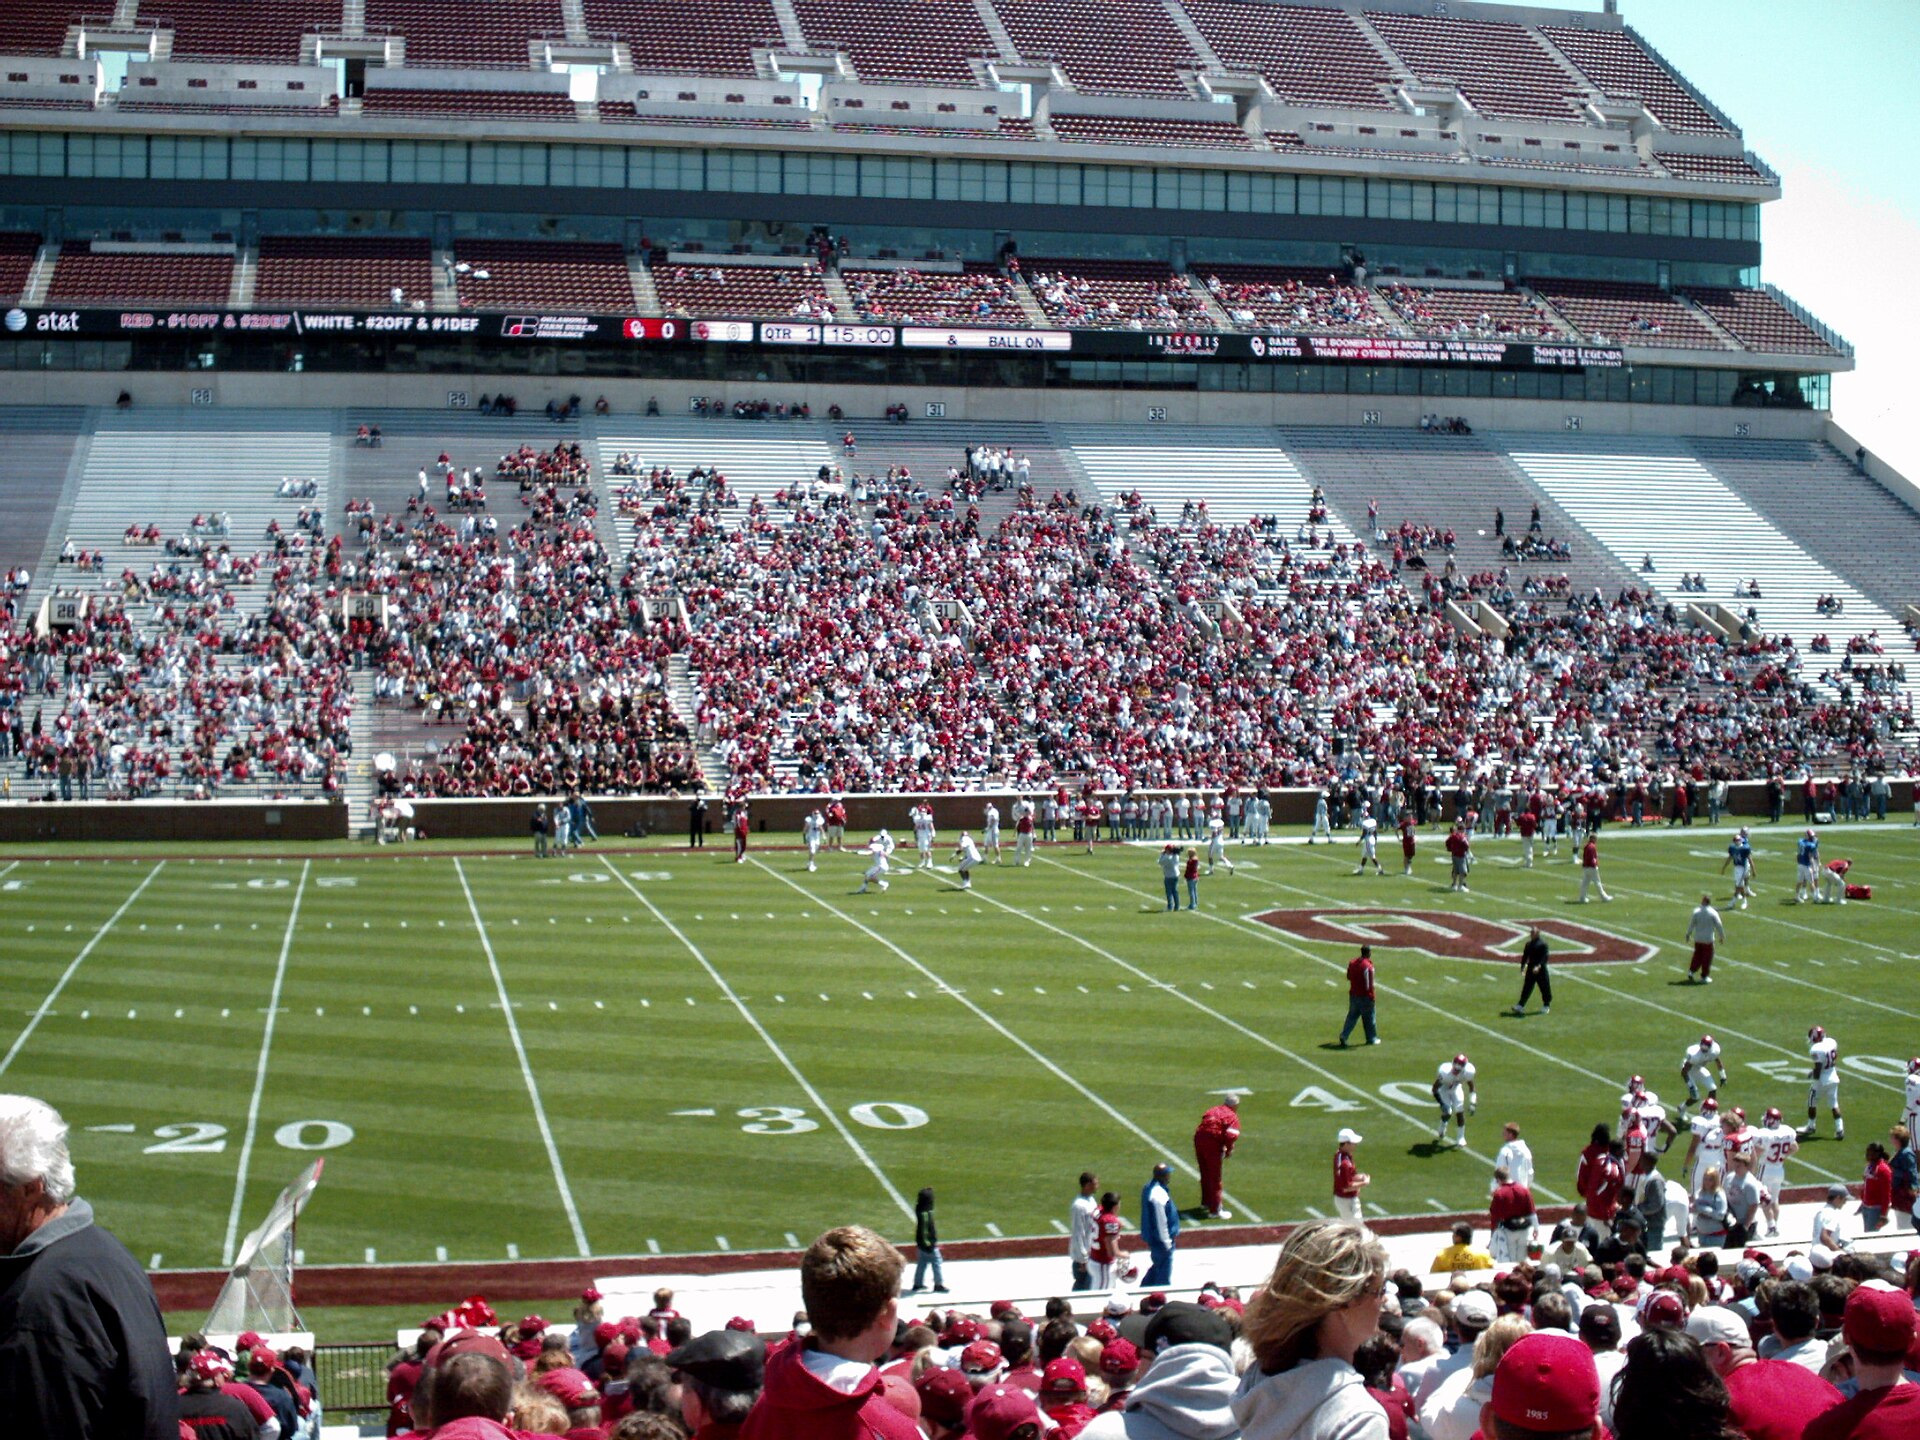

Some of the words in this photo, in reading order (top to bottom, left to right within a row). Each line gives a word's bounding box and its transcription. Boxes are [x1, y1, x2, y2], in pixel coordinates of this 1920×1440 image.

[36, 311, 79, 331] at&t
[120, 313, 154, 328] RED
[223, 314, 236, 328] &
[303, 315, 354, 329] WHITE
[416, 317, 428, 330] &
[431, 317, 479, 331] #1DEF
[661, 322, 675, 339] 0
[765, 327, 791, 340] QTR
[806, 327, 817, 341] 1
[833, 328, 892, 343] 15:00
[947, 334, 957, 346] &
[989, 336, 1021, 348] BALL
[1025, 337, 1043, 348] ON
[1147, 335, 1219, 347] INTEGRIS
[1309, 338, 1327, 347] THE
[1374, 340, 1399, 349] HAVE
[1401, 340, 1428, 349] MORE
[1446, 342, 1464, 351] WIN
[1269, 347, 1302, 356] NOTES
[1314, 347, 1338, 357] THAN
[1340, 348, 1360, 357] ANY
[1361, 349, 1392, 358] OTHER
[1393, 350, 1438, 359] PROGRAM
[1450, 351, 1468, 361] THE
[1469, 352, 1502, 362] NATION
[57, 603, 76, 618] 28
[355, 600, 374, 615] 29
[651, 602, 670, 616] 30
[934, 604, 949, 618] 31
[1767, 1142, 1791, 1163] 39
[1526, 1408, 1549, 1420] 1985
